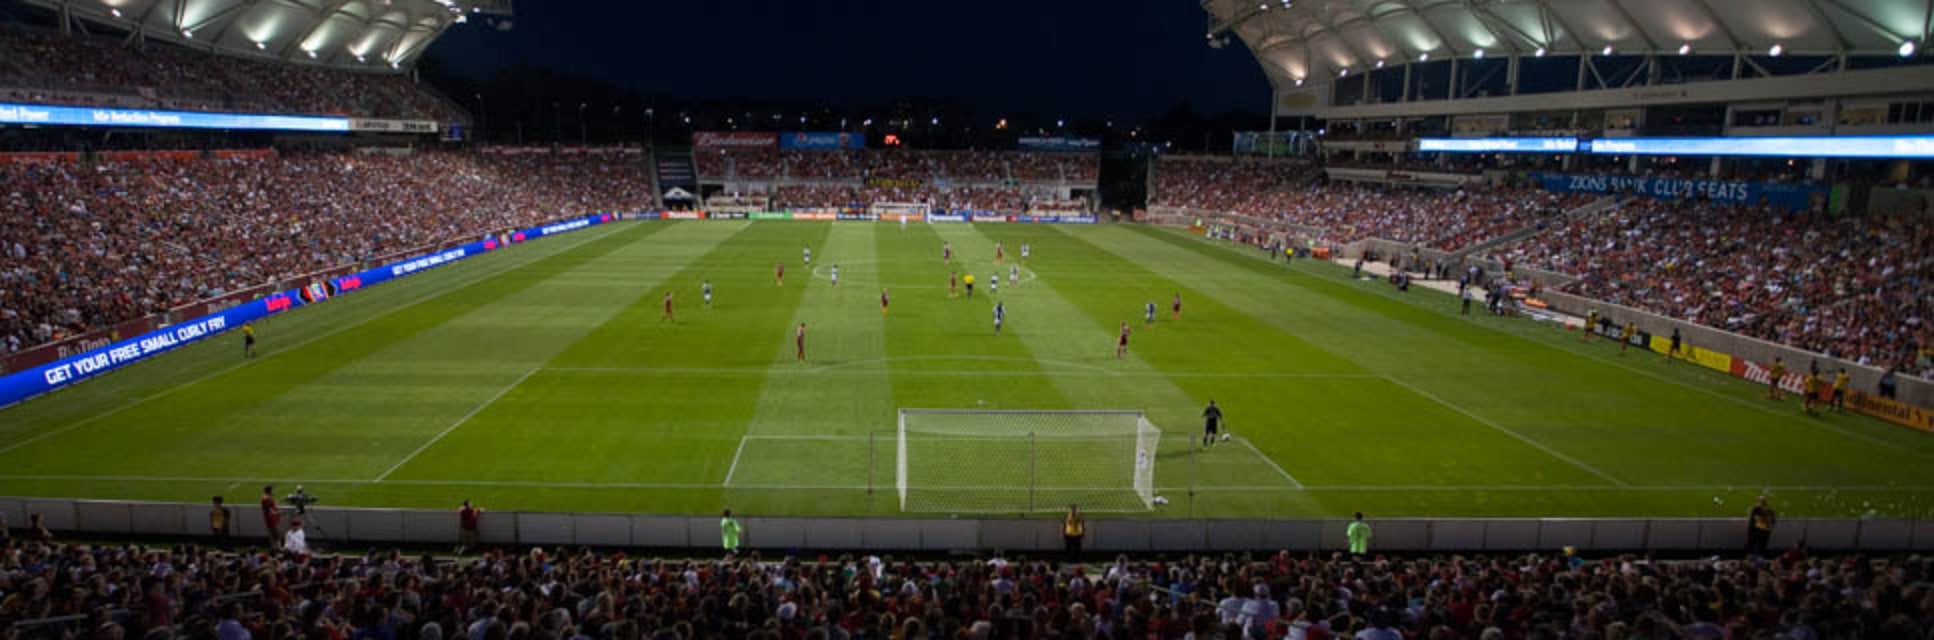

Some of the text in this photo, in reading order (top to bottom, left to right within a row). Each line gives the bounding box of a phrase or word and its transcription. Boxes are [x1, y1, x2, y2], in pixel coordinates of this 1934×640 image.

[1569, 175, 1607, 191] ZIONS
[1697, 181, 1748, 201] SEATS
[45, 315, 225, 385] GET YOUR FREE SMALL CURLY FRY
[1743, 360, 1805, 395] Maita
